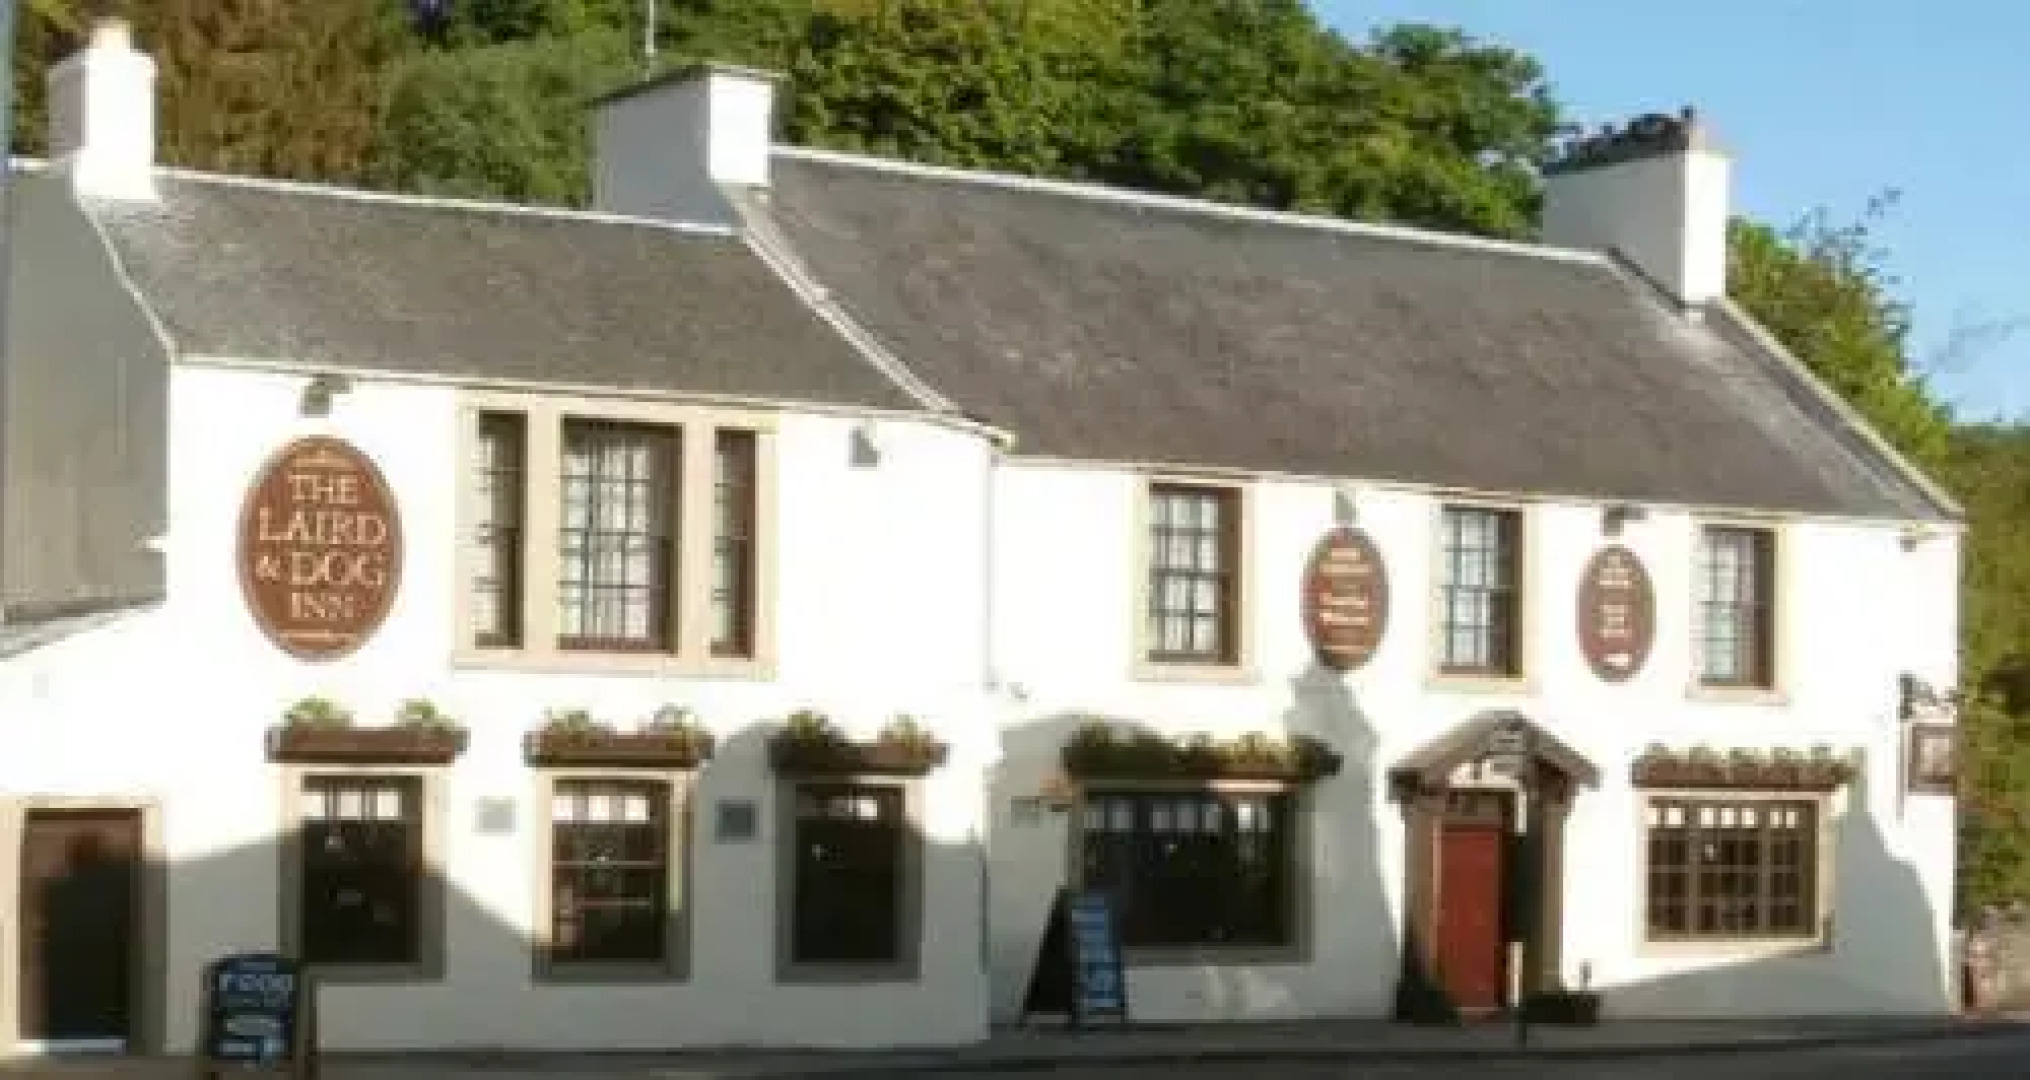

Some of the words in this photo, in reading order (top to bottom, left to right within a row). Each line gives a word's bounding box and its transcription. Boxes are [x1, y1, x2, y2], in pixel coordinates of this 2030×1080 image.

[288, 474, 358, 504] THE
[258, 508, 387, 544] LAIRD
[255, 555, 282, 579] &
[290, 552, 386, 587] DOG
[291, 592, 354, 619] INN
